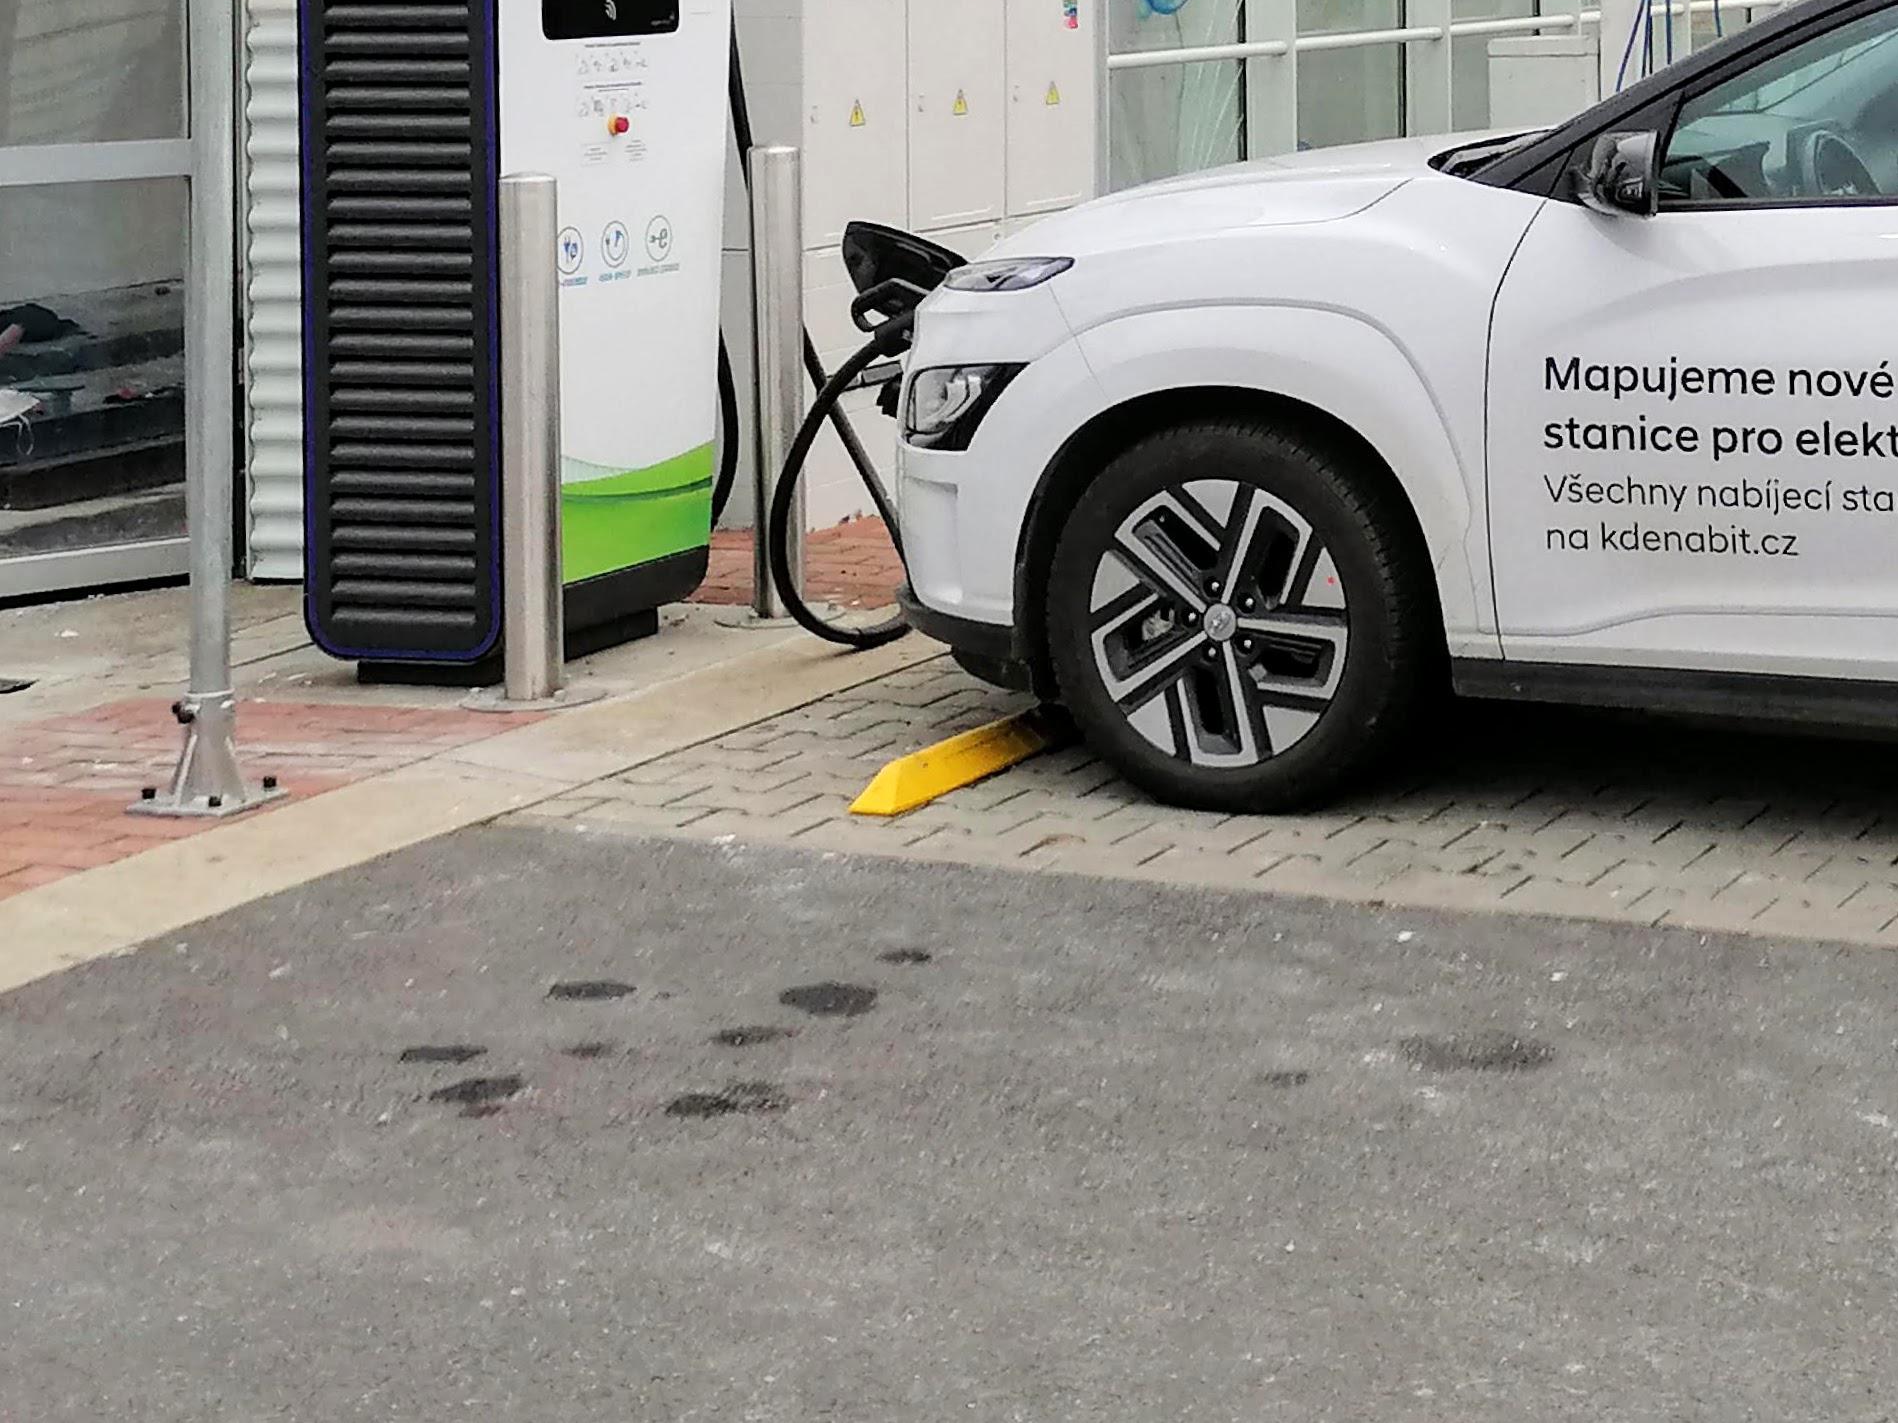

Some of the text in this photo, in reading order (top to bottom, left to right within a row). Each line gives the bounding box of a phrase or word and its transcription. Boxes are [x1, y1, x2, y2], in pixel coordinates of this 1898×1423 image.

[1545, 356, 1775, 400] Mapujeme
[1788, 361, 1894, 398] nové
[1544, 414, 1699, 453] stanice
[1713, 425, 1783, 461] pro
[1544, 473, 1687, 512] Všechny
[1698, 478, 1832, 515] nabíjecí
[1547, 521, 1799, 556] na kdenabit.cz
